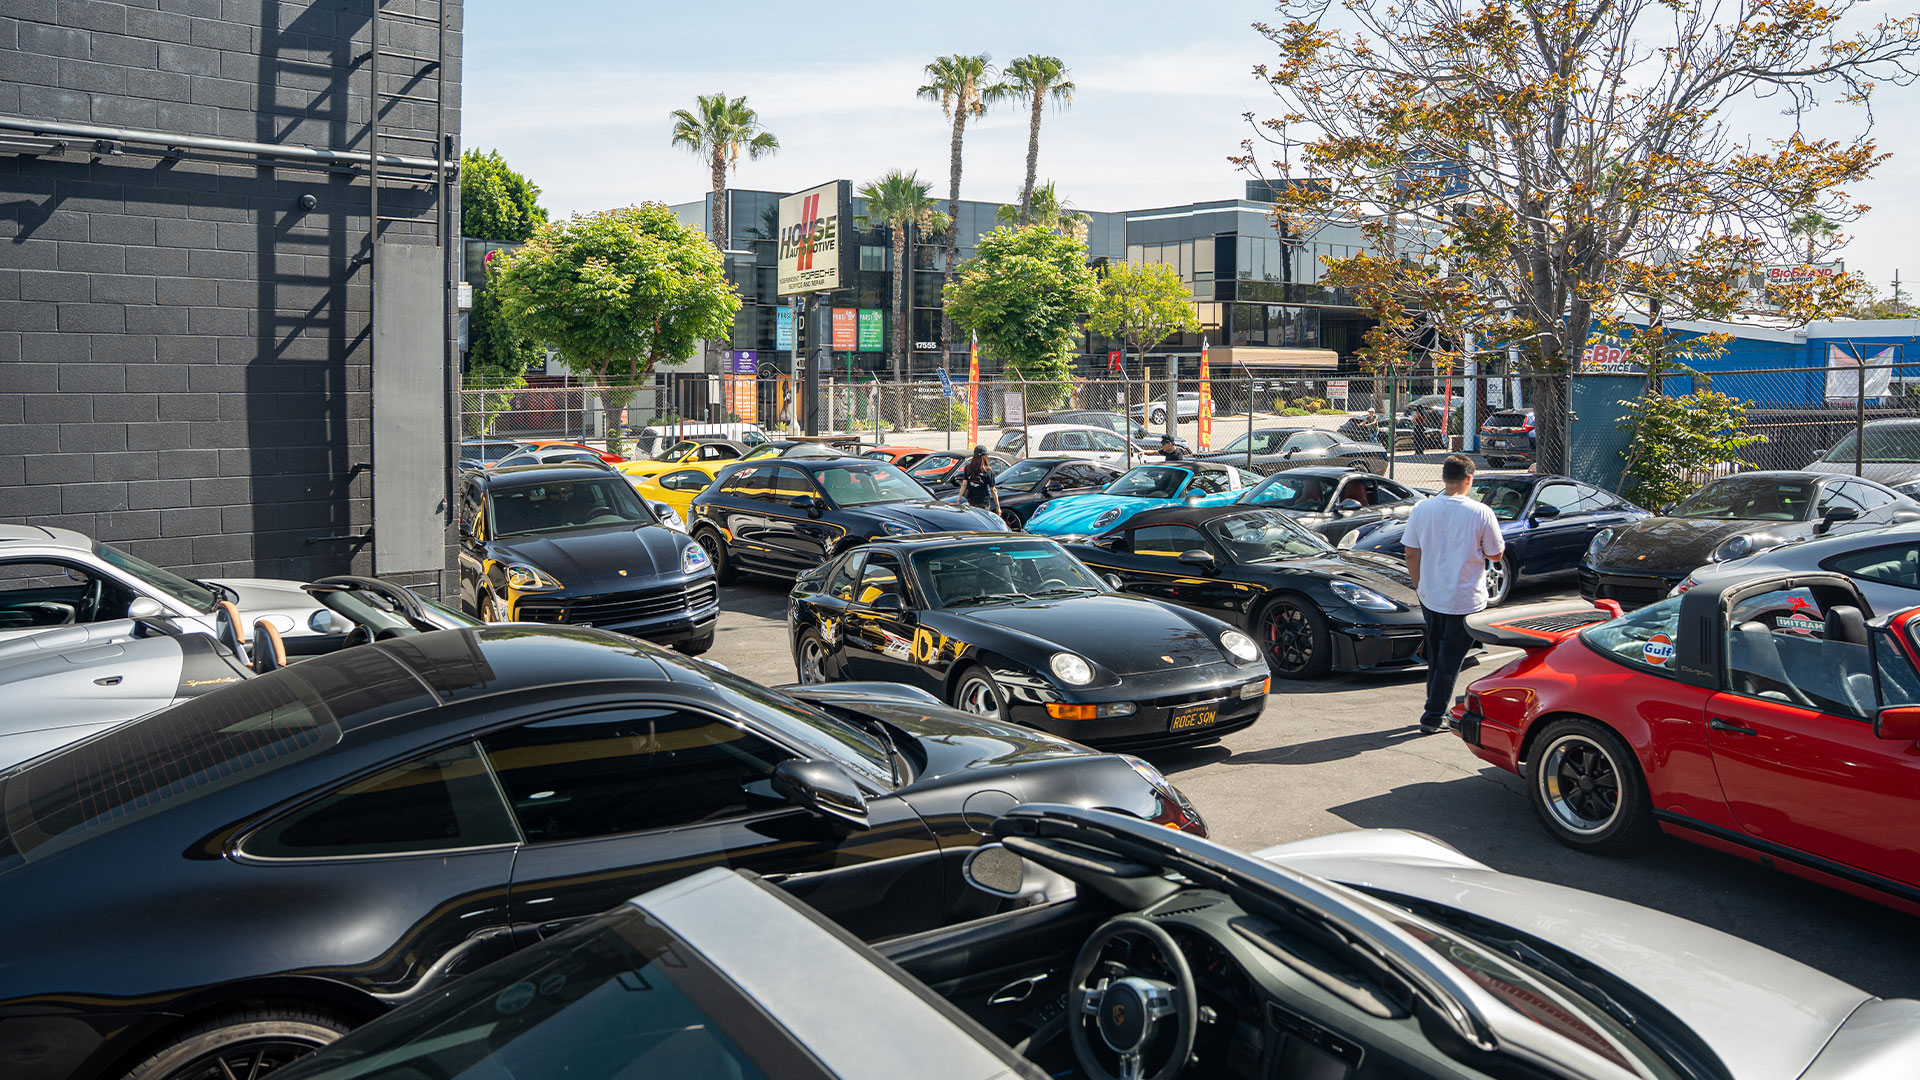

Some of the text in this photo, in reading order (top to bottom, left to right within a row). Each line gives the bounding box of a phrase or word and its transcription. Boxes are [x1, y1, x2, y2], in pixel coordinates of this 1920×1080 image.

[780, 215, 838, 260] HOUSE
[789, 240, 835, 258] AUTOMOTIVE
[801, 268, 836, 280] PORSCHE
[1771, 268, 1791, 278] BIG
[915, 341, 937, 349] 17555
[1644, 642, 1673, 656] Gulf
[1185, 706, 1209, 714] CALIFORNIA
[1173, 713, 1198, 729] ROGE
